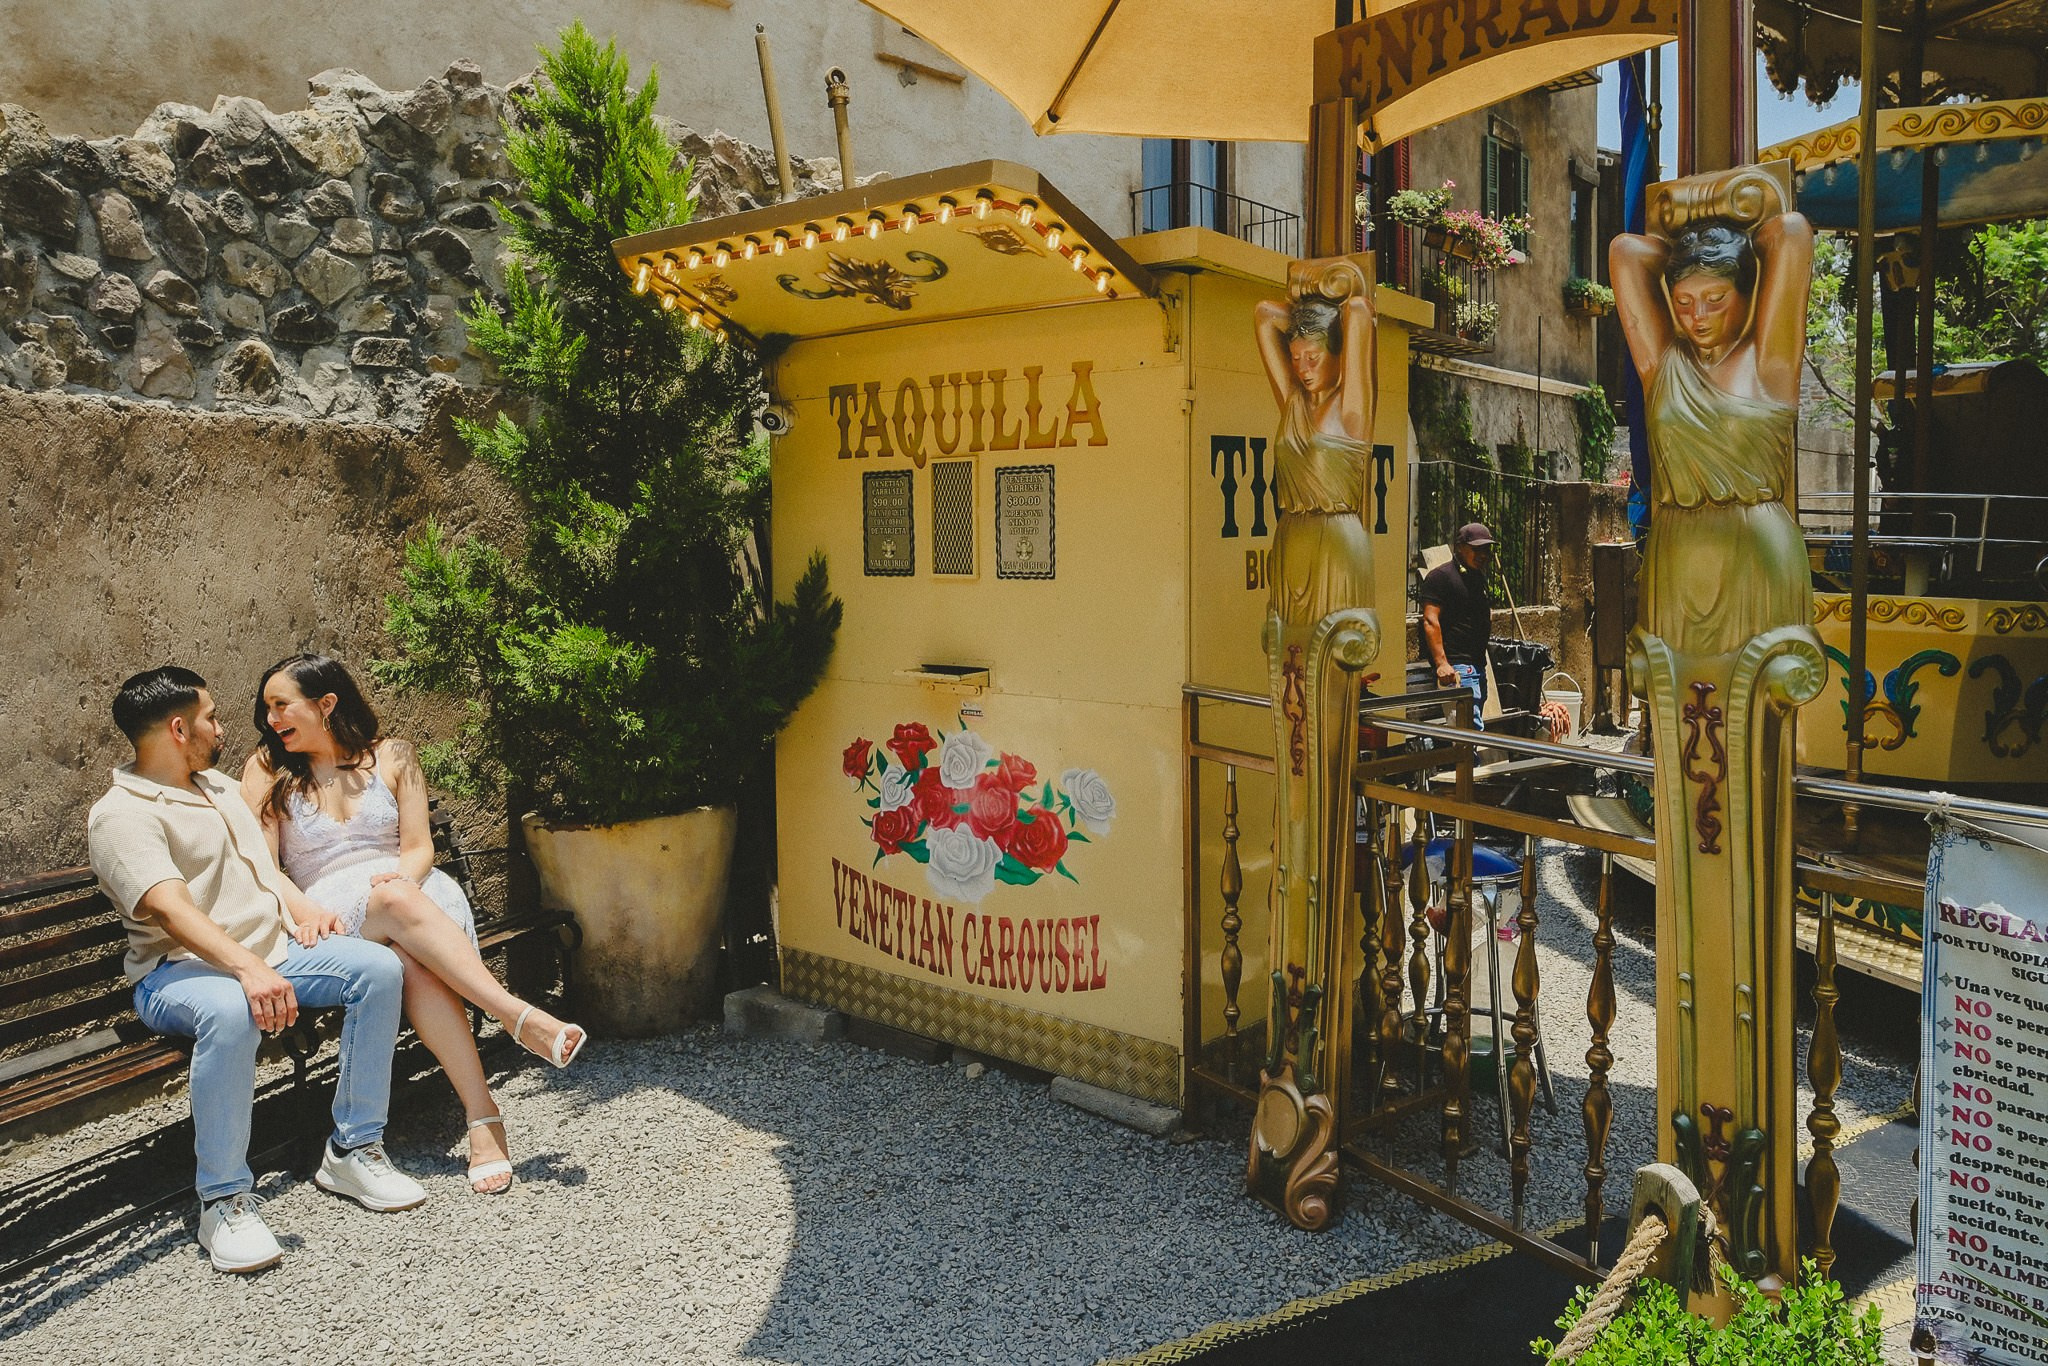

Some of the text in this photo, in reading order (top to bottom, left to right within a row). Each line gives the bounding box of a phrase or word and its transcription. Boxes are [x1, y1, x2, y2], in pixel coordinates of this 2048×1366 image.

[829, 361, 1108, 469] TAQUILLA
[871, 480, 904, 488] VENETIAN
[1007, 495, 1040, 507] $80.00
[880, 527, 907, 535] TARJETA
[831, 856, 1107, 994] VENETIAN CAROUSEL
[1932, 931, 1964, 948] POR
[1966, 939, 1990, 953] TU
[1954, 976, 1990, 995] Una
[1993, 988, 2021, 1004] vez
[1955, 994, 1992, 1018] NO
[1996, 1012, 2013, 1024] se
[1955, 1018, 1991, 1041] NO
[1996, 1036, 2013, 1048] se
[1954, 1041, 1991, 1065] NO
[1995, 1060, 2013, 1072] se
[1953, 1065, 2034, 1096] ebriedad.
[1953, 1082, 1992, 1105] NO
[1952, 1105, 1993, 1128] NO
[1997, 1123, 2014, 1136] se
[1951, 1128, 1992, 1152] NO
[1996, 1147, 2014, 1159] se
[1949, 1152, 2048, 1188] desprende
[1949, 1169, 2045, 1210] NO subir
[1948, 1194, 2048, 1230] suelto, fav
[1948, 1211, 2044, 1246] accidente.
[1948, 1226, 1988, 1253] NO
[1939, 1270, 1998, 1297] ANTES
[1947, 1248, 2048, 1289] TOTALME
[1918, 1283, 1970, 1304] SIGUE
[1920, 1306, 1968, 1326] AVISO,
[1971, 1317, 1993, 1331] NO
[1996, 1325, 2029, 1344] NOS
